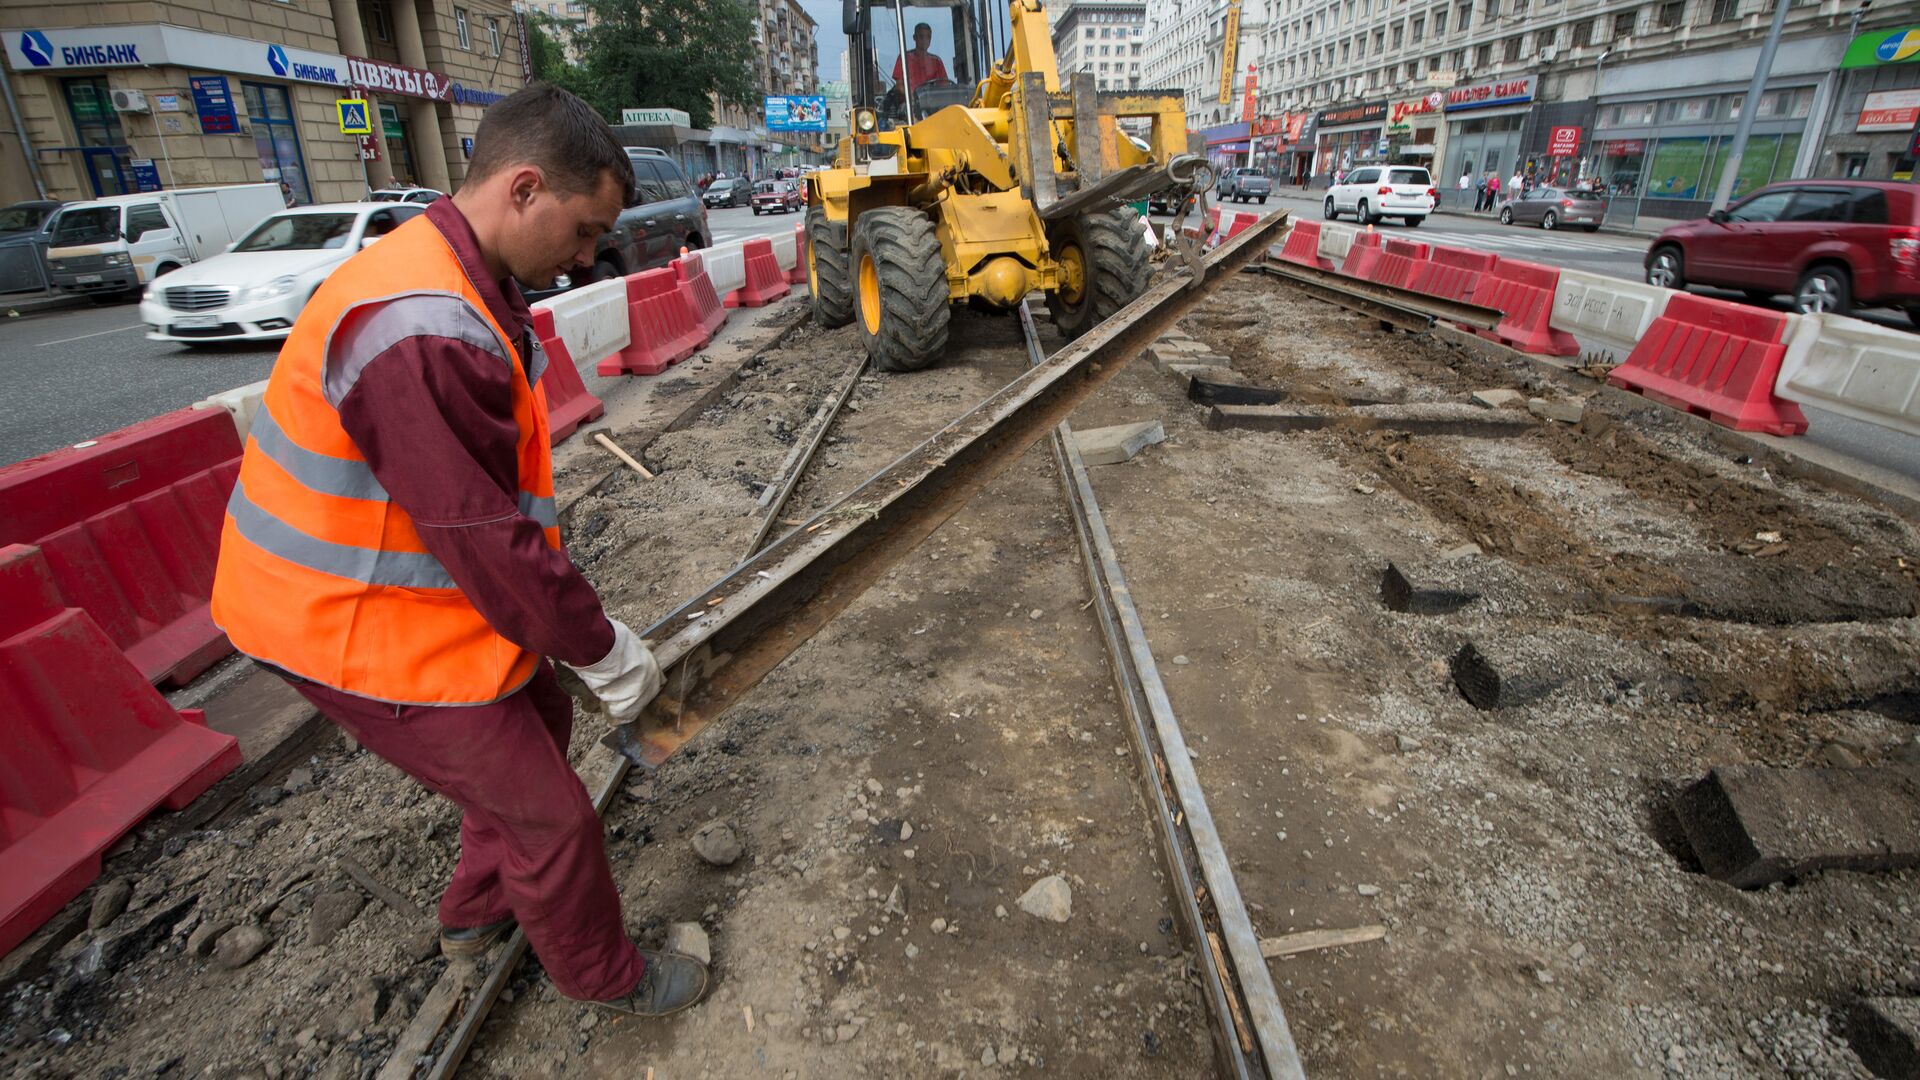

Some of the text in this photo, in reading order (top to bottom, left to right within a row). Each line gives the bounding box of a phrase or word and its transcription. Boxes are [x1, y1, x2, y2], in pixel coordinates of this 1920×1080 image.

[61, 44, 140, 65] БИНБАНК
[293, 62, 338, 83] БИНБАНК
[349, 60, 423, 94] ЦВЕТЫ
[1448, 79, 1529, 103] МАСТЕР БАНК
[625, 112, 671, 122] АПТЕКА
